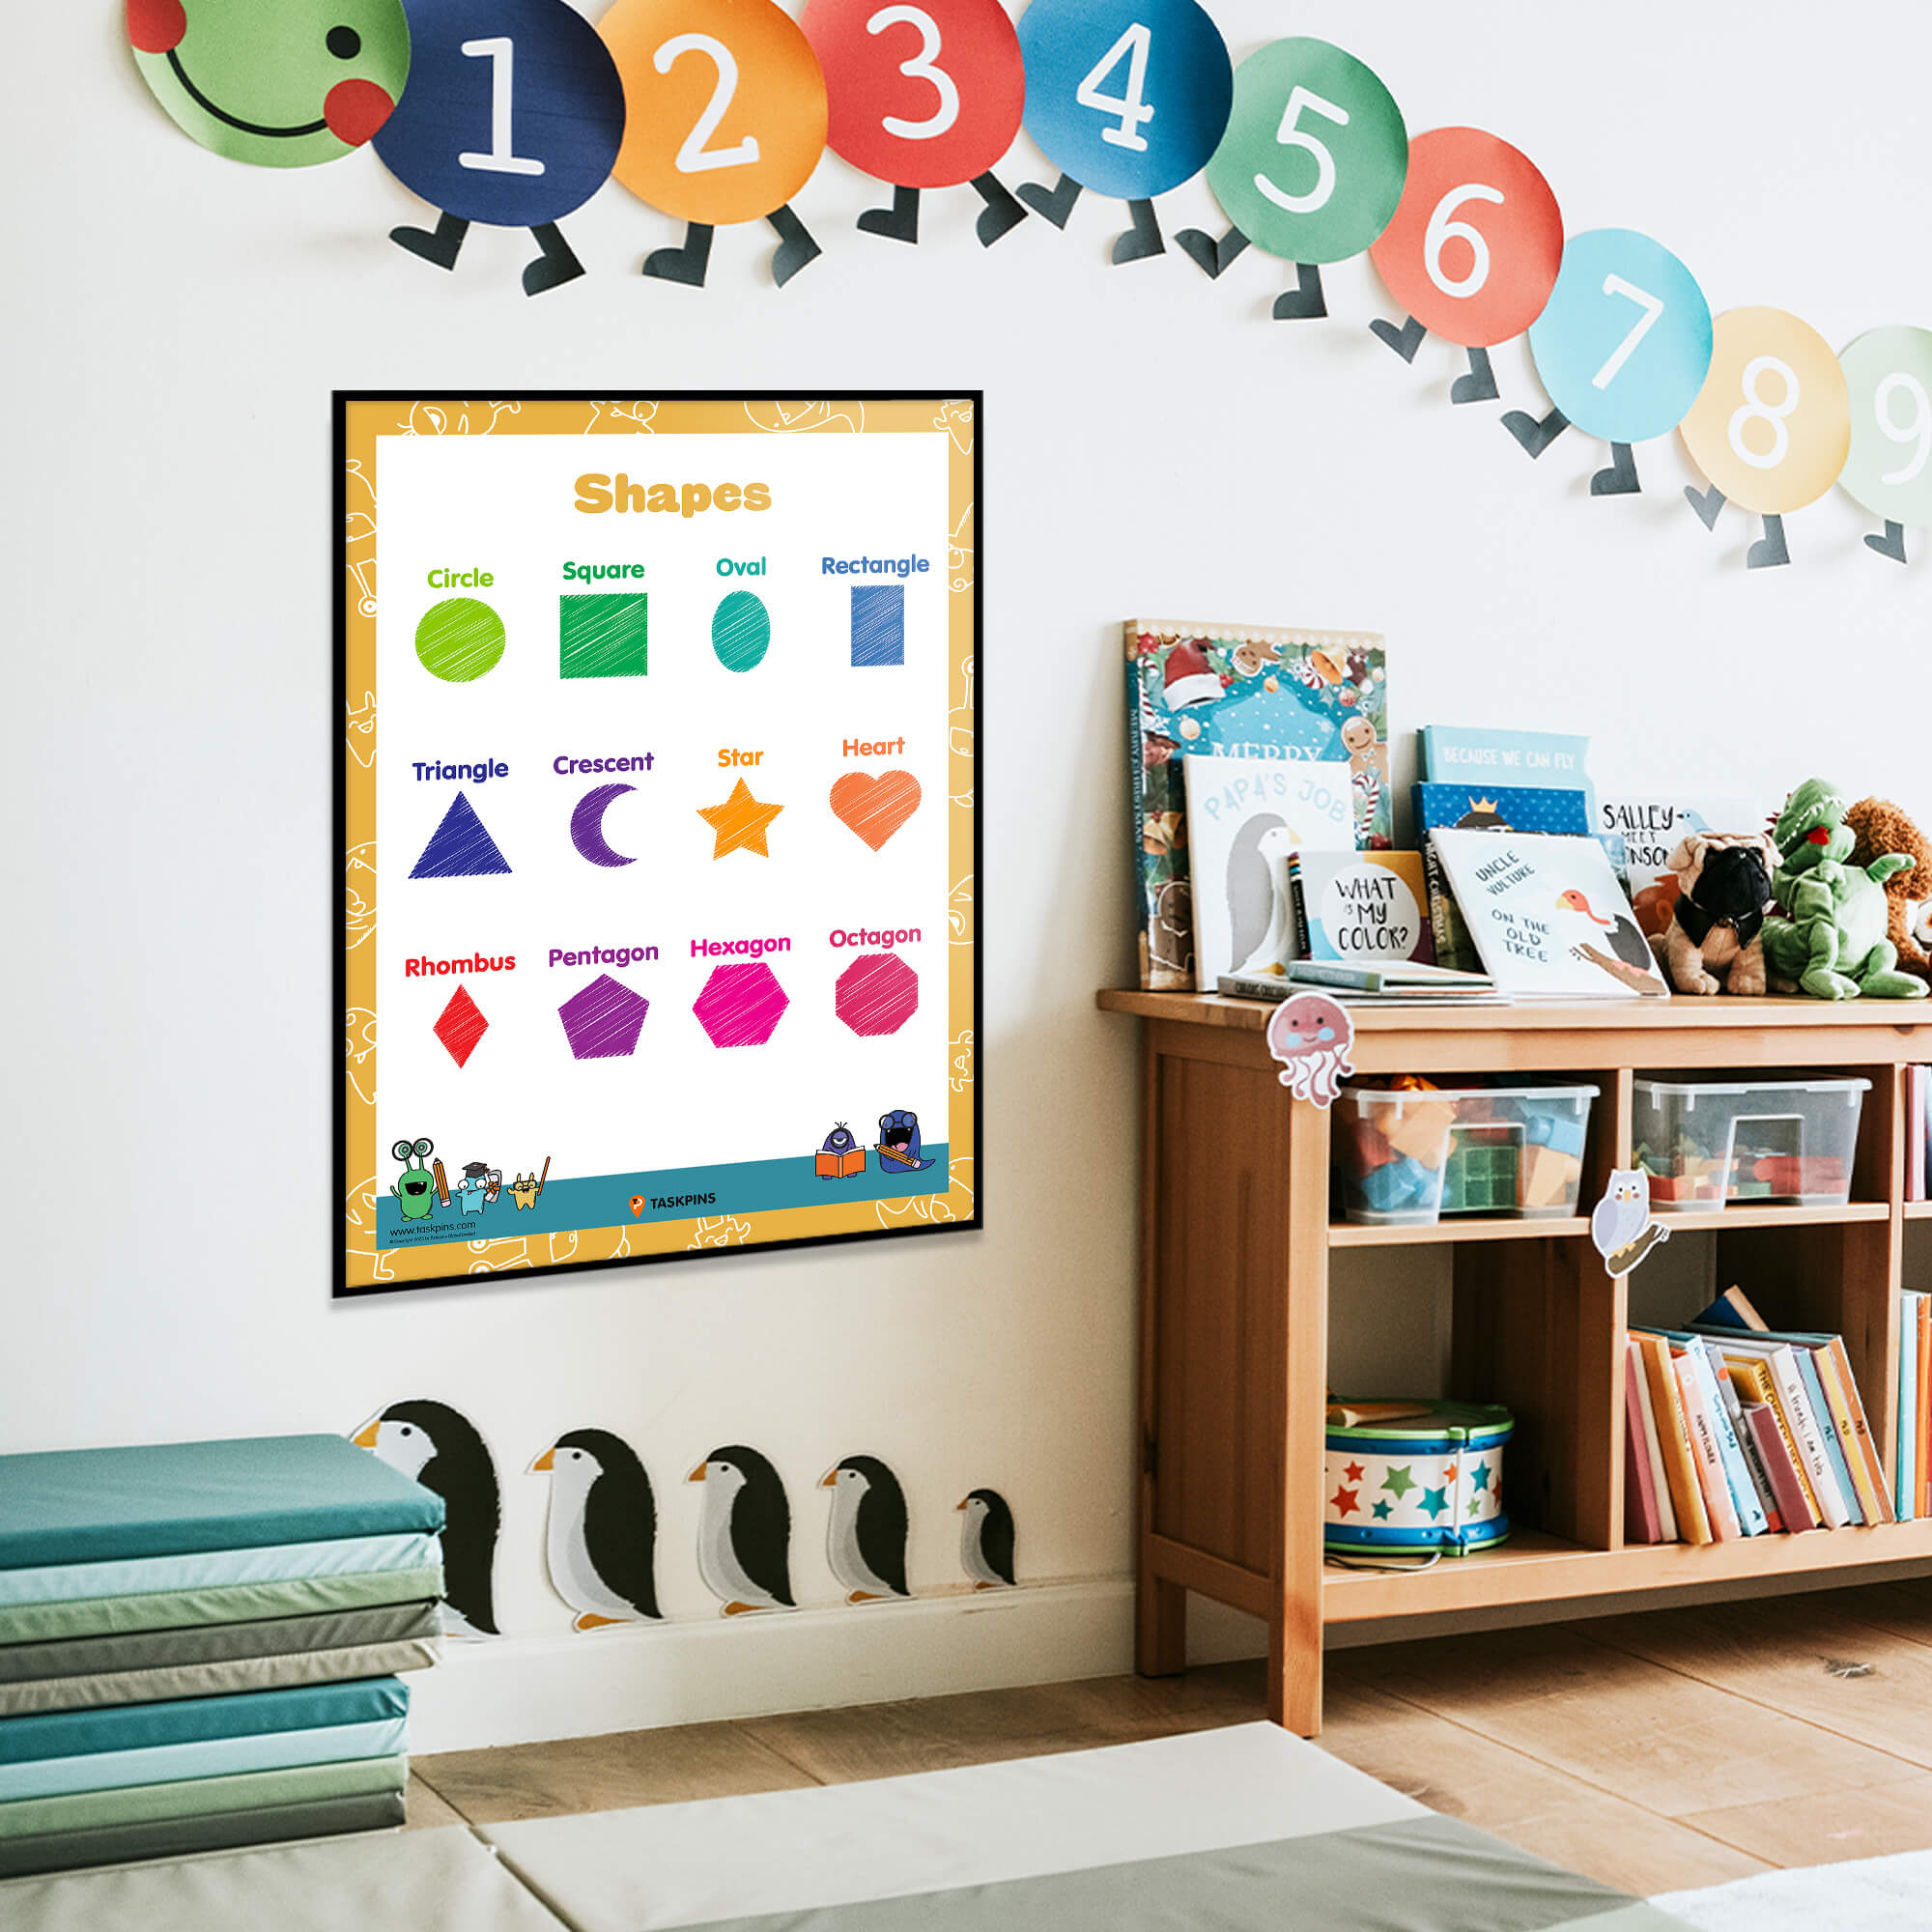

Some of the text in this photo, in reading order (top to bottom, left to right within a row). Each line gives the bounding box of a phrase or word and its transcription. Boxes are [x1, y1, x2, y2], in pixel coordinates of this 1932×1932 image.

[867, 5, 958, 139] 3
[1076, 22, 1154, 152] 4
[459, 38, 545, 175] 1
[653, 33, 759, 173] 2
[1254, 85, 1350, 213] 5
[1424, 184, 1505, 298] 6
[1592, 273, 1664, 390] 7
[1727, 355, 1801, 469] 8
[1874, 372, 1932, 484] 9
[574, 472, 772, 519] Shapes
[427, 566, 495, 589] Circle
[562, 560, 645, 585] Square
[716, 555, 767, 578] Oval
[821, 553, 930, 579] Rectangle
[717, 748, 764, 768] Star
[842, 736, 906, 757] Heart
[1443, 747, 1577, 770] BECAUSE WE CAN FLY
[412, 757, 509, 784] Triangle
[553, 752, 655, 776] Crescent
[1205, 772, 1346, 822] PAPA'S JOB
[1603, 804, 1674, 831] SALLEY
[1475, 849, 1520, 882] UNCLE
[1335, 877, 1397, 899] WHAT
[1487, 864, 1536, 896] VULTURE
[1492, 908, 1550, 936] ON THE
[690, 934, 792, 959] Hexagon
[829, 924, 923, 950] Octagon
[1339, 926, 1408, 951] COLOR?
[1507, 926, 1542, 947] OLD
[548, 943, 660, 969] Pentagon
[1502, 938, 1548, 963] TREE
[405, 952, 517, 978] Rhombus
[650, 1192, 717, 1209] TASKPINS
[389, 1221, 476, 1236] www.taskpins.com
[1758, 1369, 1772, 1391] THE
